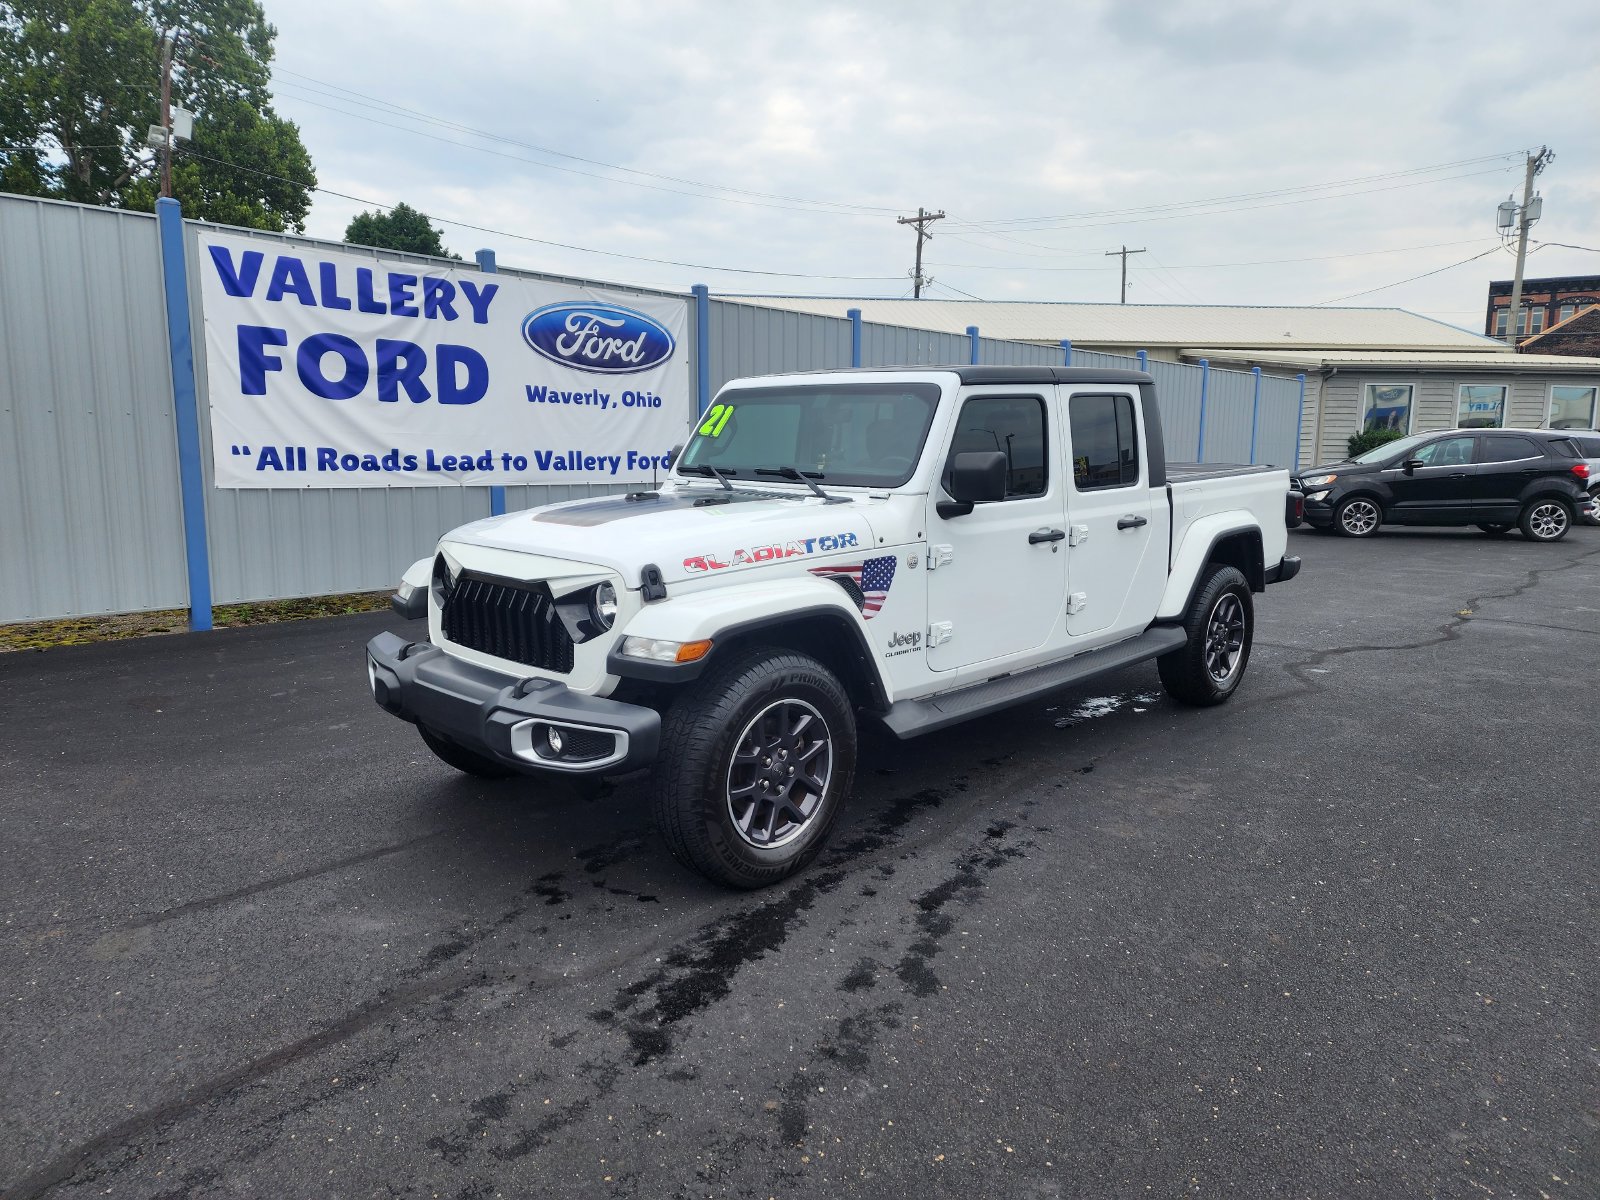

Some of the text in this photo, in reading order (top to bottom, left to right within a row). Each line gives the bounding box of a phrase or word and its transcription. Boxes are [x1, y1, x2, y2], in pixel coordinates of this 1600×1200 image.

[208, 245, 499, 325] VALLERY
[556, 311, 647, 362] Ford
[237, 325, 490, 405] FORD
[525, 385, 662, 409] Waverly, Ohio
[699, 404, 734, 437] 21
[317, 447, 419, 472] Roads
[426, 448, 494, 472] Lead
[501, 452, 528, 472] to
[533, 450, 621, 476] Vallery
[627, 450, 673, 471] Ford
[682, 532, 860, 573] GLADIATOR
[885, 646, 922, 658] GLADIATOR
[888, 631, 921, 648] Jeep
